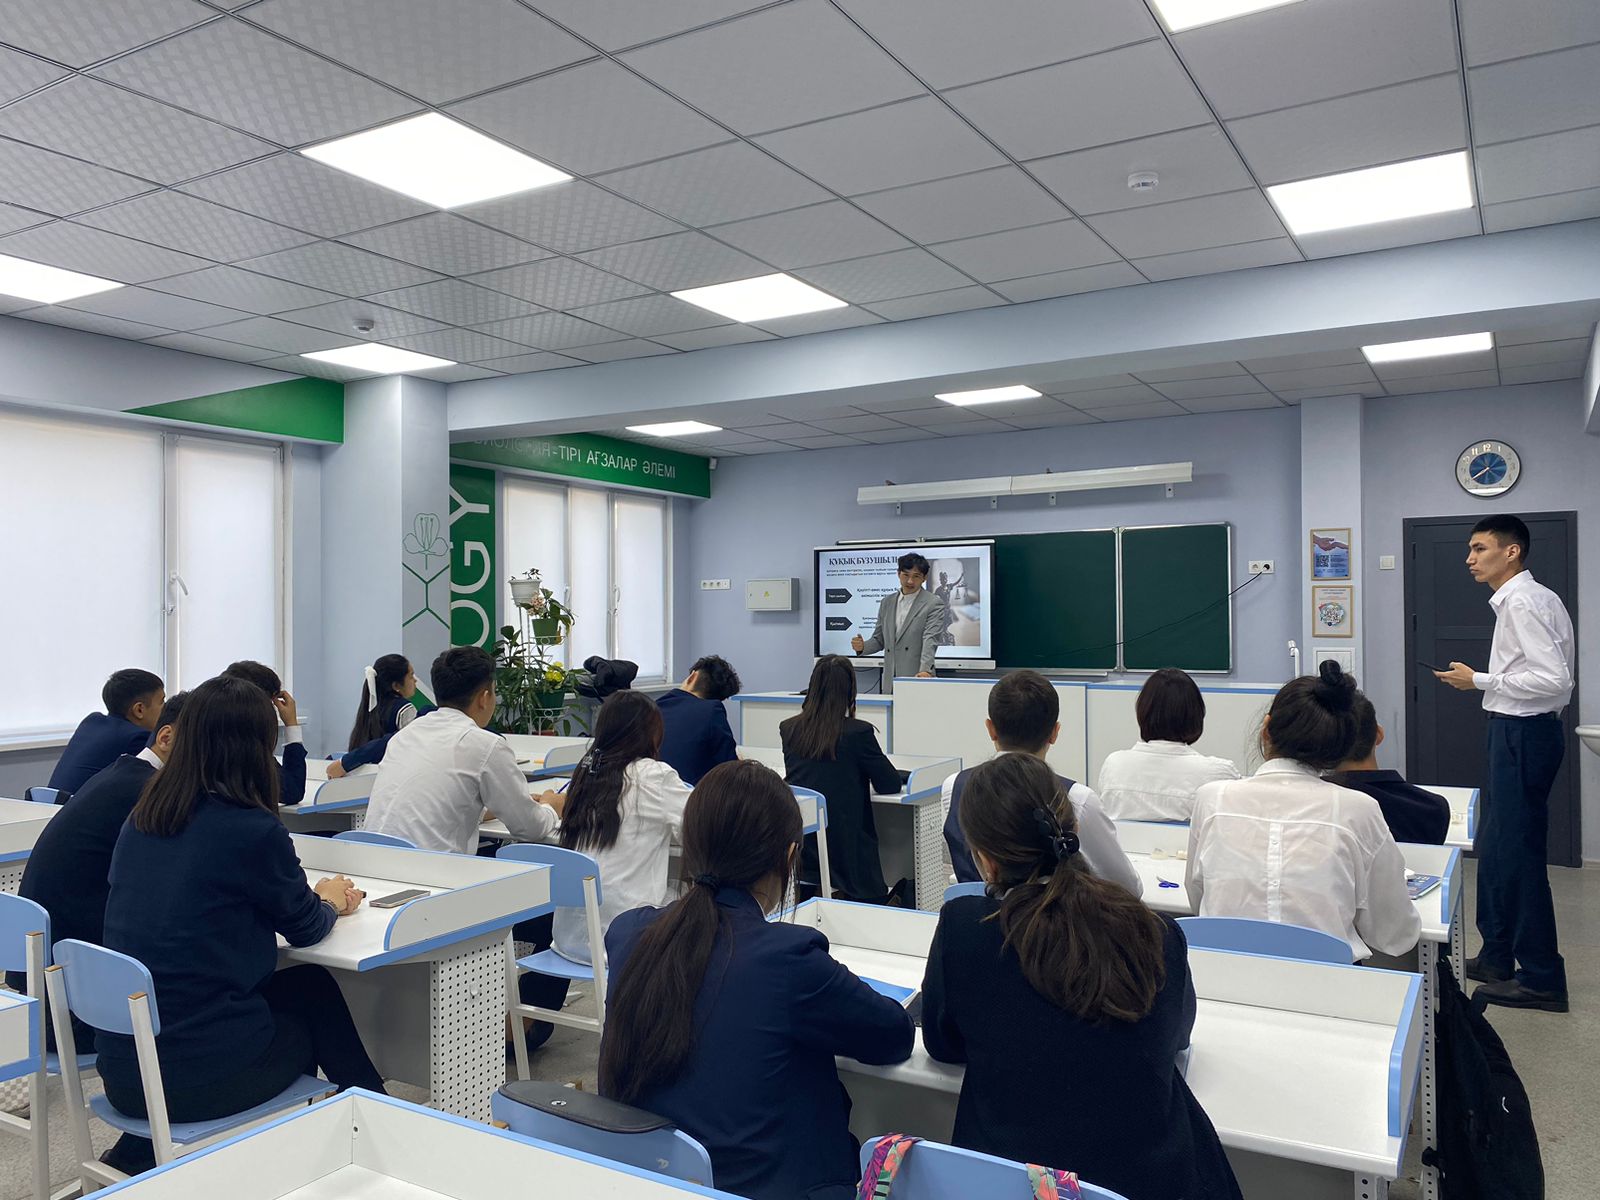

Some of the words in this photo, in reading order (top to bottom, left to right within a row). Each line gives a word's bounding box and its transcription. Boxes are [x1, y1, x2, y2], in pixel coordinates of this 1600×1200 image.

[586, 450, 638, 471] АҒЗАЛАР
[642, 461, 676, 479] ӘЛЕМІ
[449, 484, 490, 649] OGY
